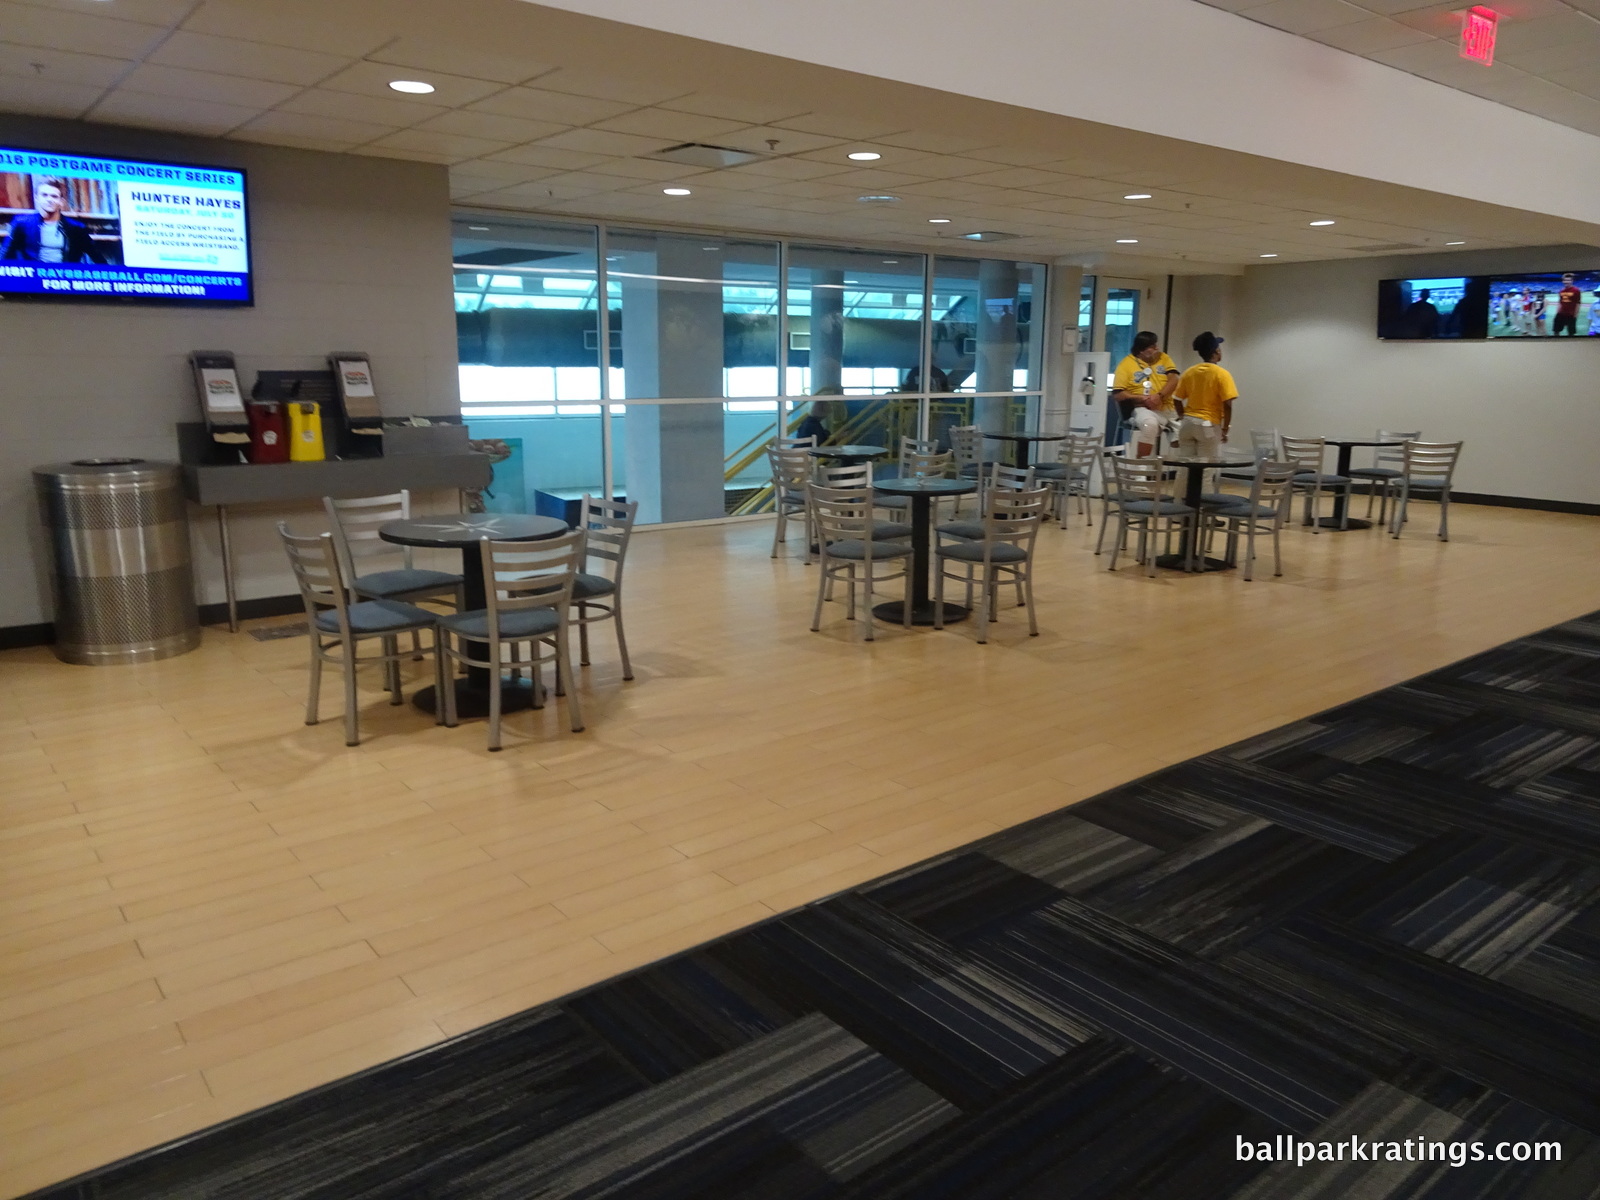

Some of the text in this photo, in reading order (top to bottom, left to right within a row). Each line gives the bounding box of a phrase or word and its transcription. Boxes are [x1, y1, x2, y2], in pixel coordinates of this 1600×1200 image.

[28, 155, 113, 173] POSTGAME
[116, 164, 182, 180] CONCERT
[185, 170, 236, 185] SERIES
[131, 191, 242, 210] HUNTER HAYES
[176, 223, 211, 231] CONCERT
[188, 233, 237, 241] PURCHASING
[37, 268, 243, 287] RAYSBASEBALL.COM/CONCERTS
[42, 279, 206, 296] FOR MORE INFORMATION!
